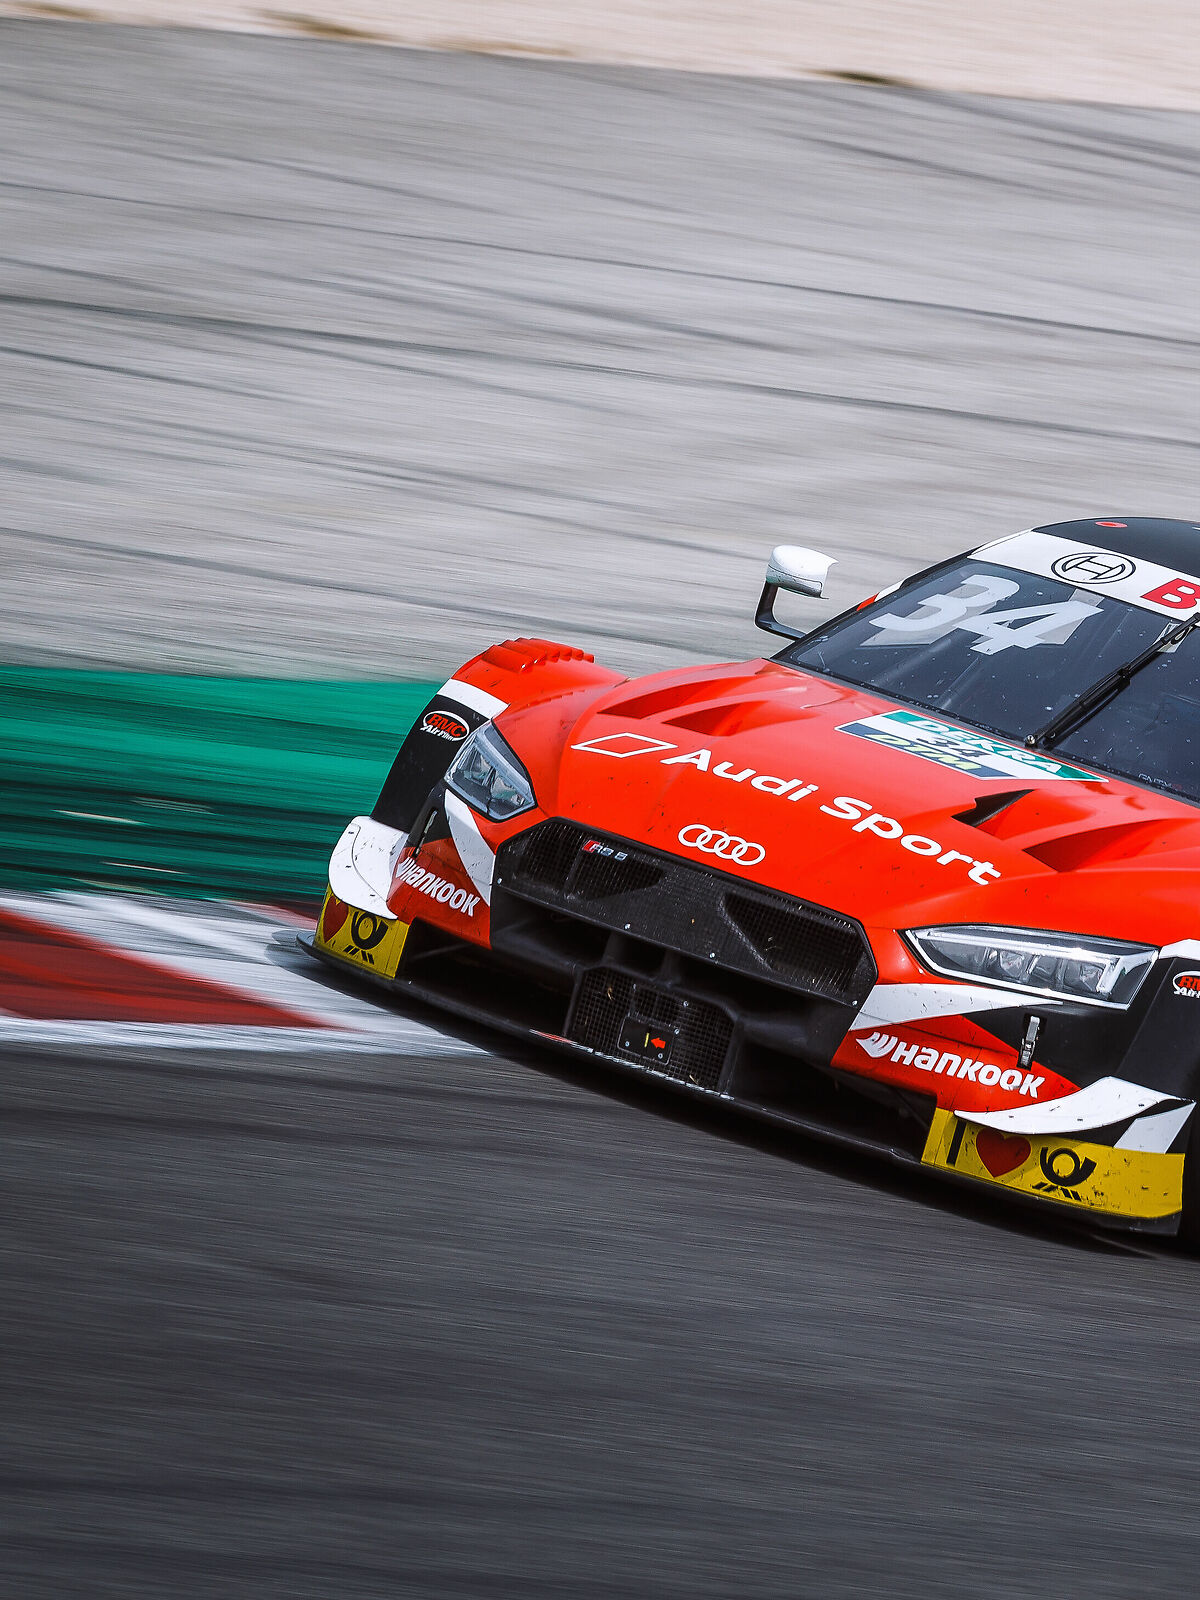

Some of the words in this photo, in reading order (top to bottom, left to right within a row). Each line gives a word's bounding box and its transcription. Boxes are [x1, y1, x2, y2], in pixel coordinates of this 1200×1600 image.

[868, 574, 1105, 655] 34
[426, 713, 466, 737] BMC
[905, 720, 1063, 773] DEKRA
[916, 737, 993, 757] 34
[865, 734, 982, 769] DTM
[660, 749, 818, 802] Audi
[819, 796, 1002, 886] Sport
[946, 1118, 967, 1167] I
